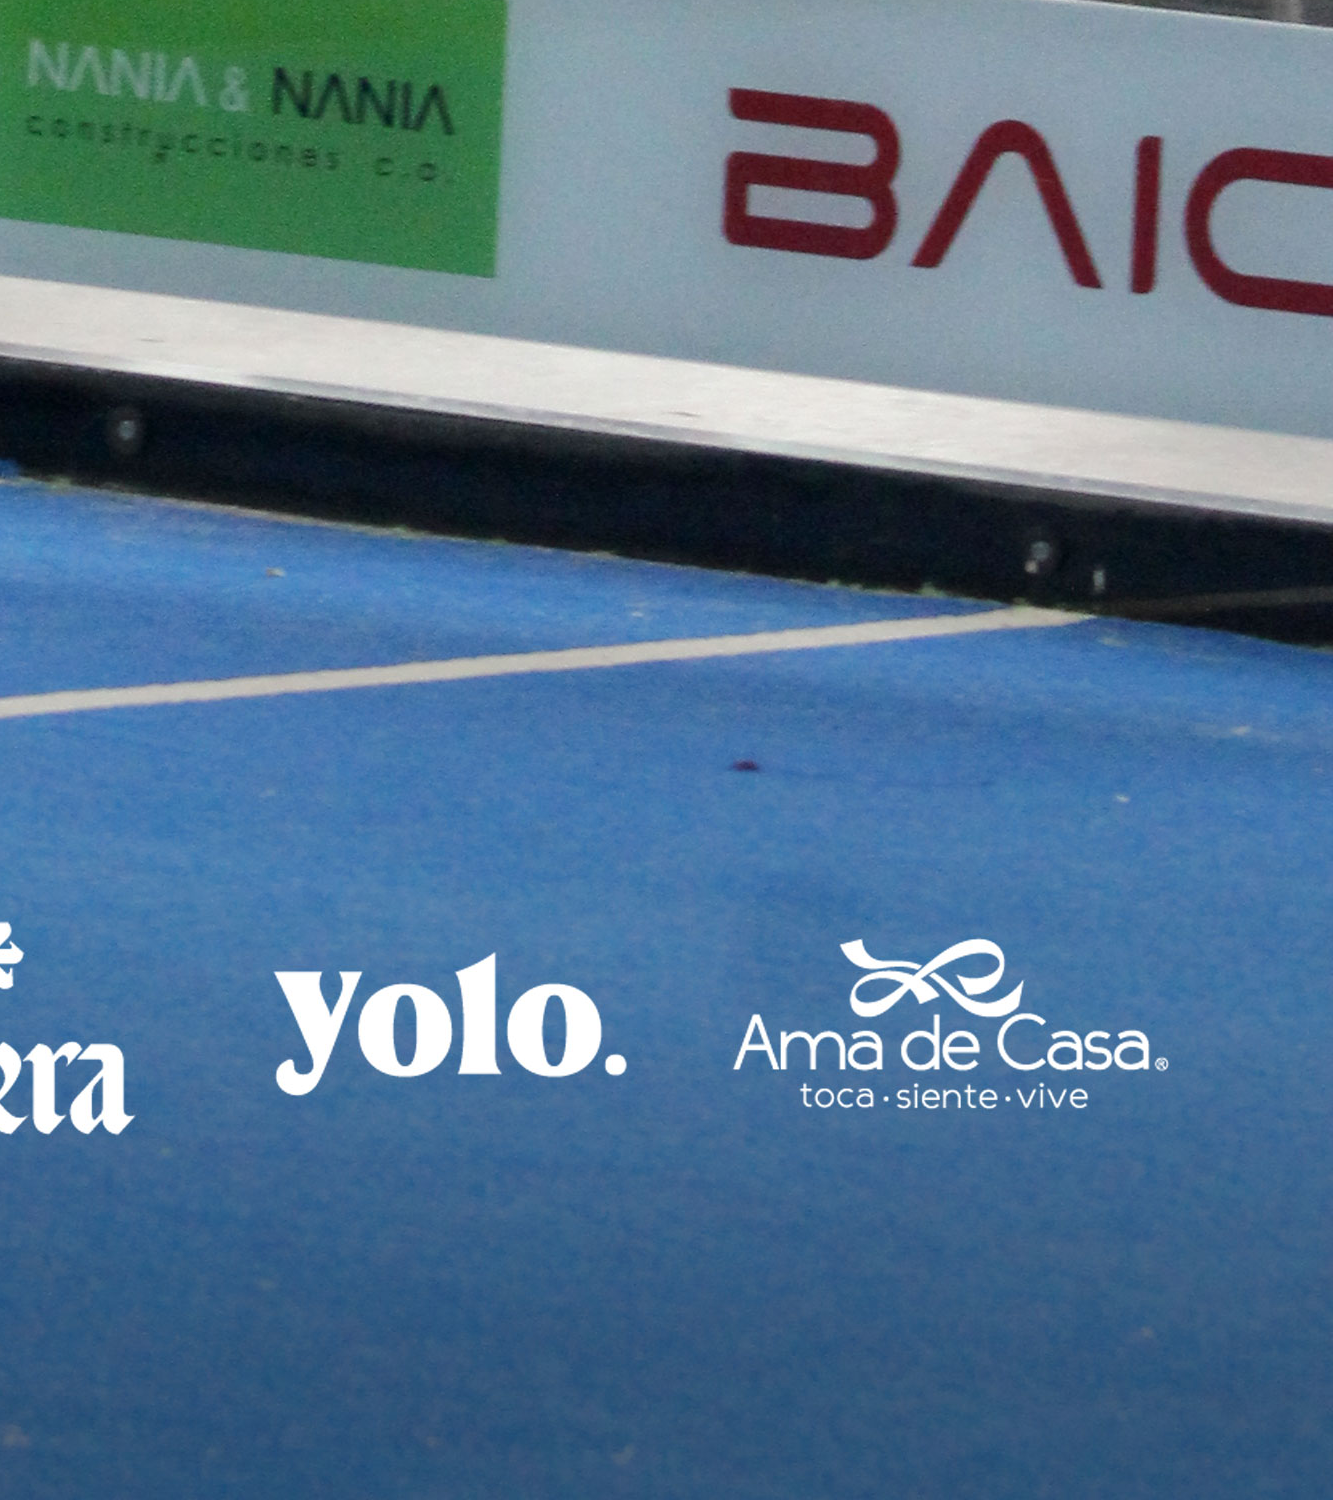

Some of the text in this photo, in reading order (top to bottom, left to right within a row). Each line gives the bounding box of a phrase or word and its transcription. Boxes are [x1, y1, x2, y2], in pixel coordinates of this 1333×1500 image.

[29, 37, 457, 136] NANIA & NANIA
[722, 86, 1333, 317] BAIC
